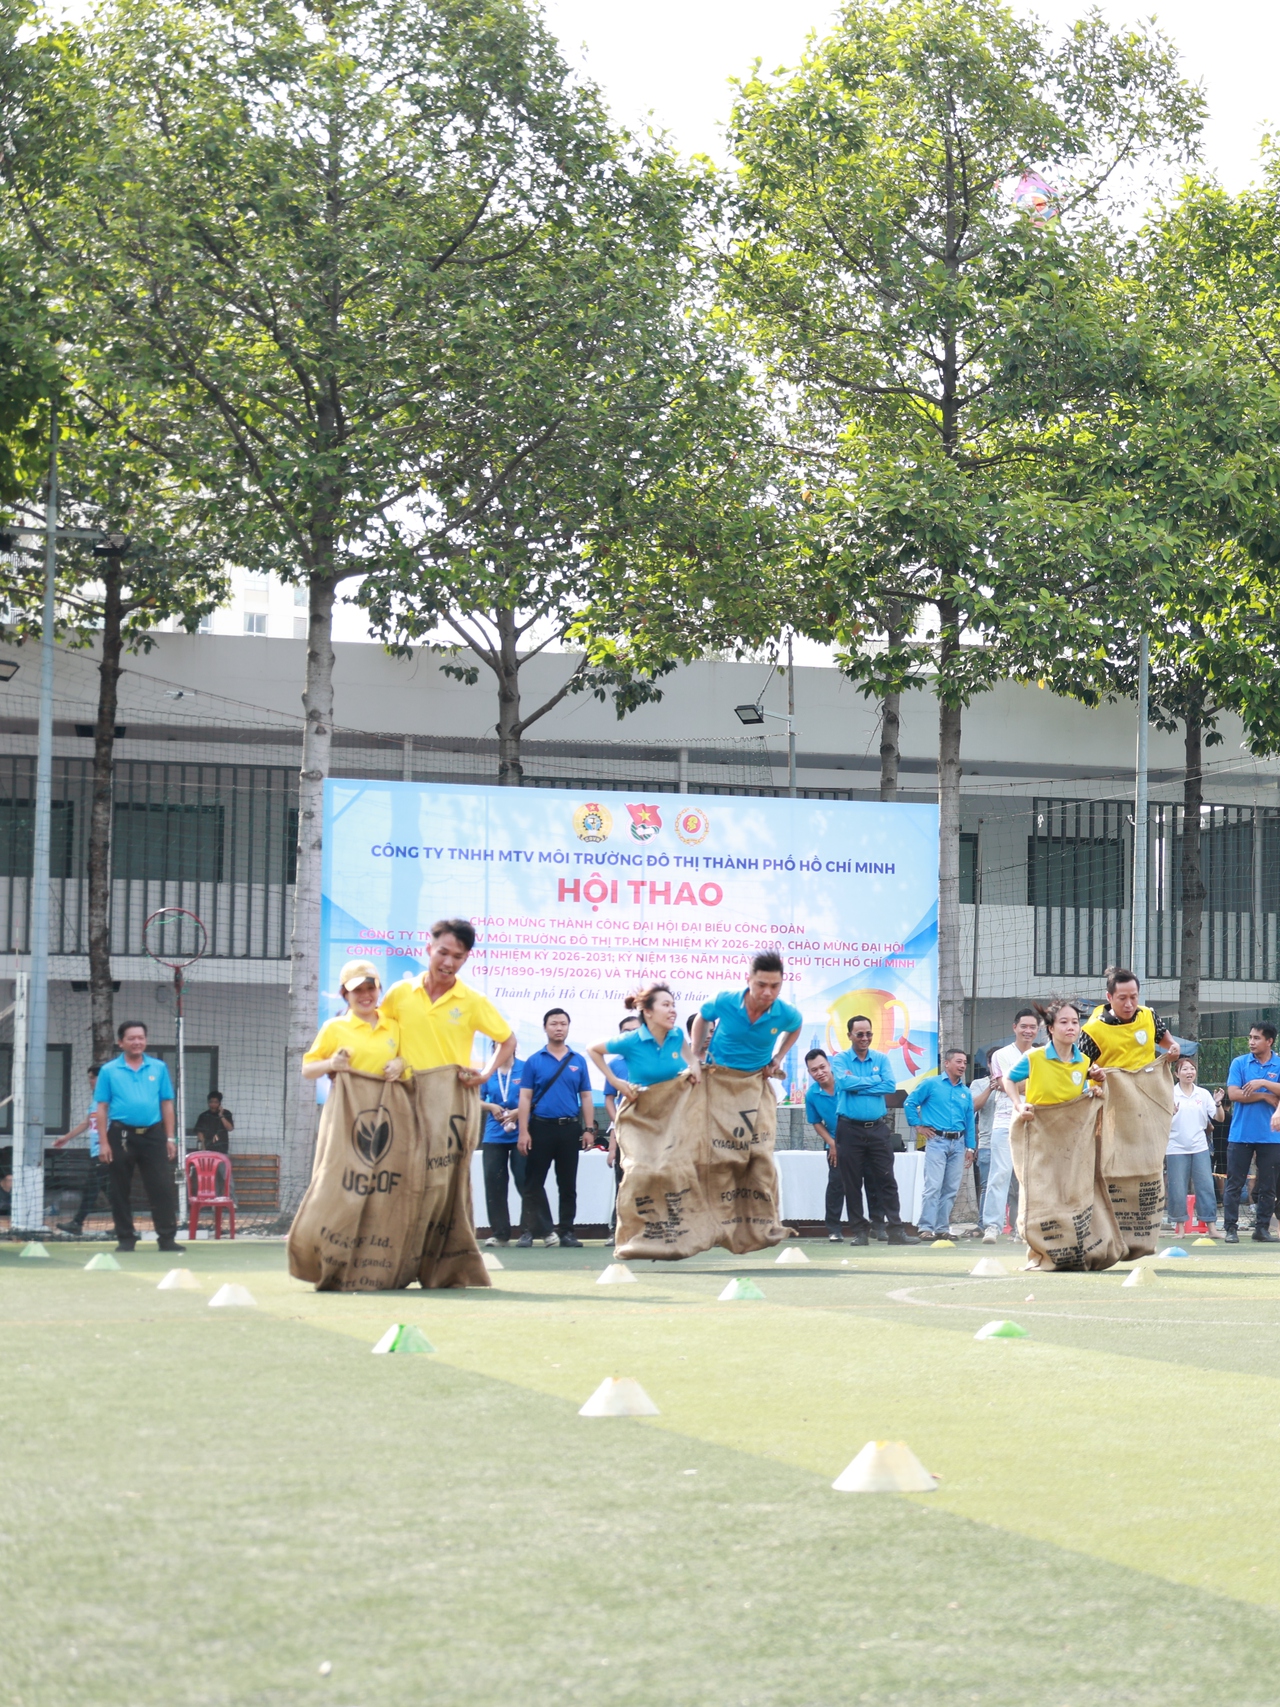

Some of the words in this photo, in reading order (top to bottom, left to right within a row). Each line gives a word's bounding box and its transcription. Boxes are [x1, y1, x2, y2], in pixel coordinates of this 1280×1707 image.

[371, 842, 419, 859] CÔNG
[423, 847, 444, 860] TY
[447, 847, 494, 862] TNHH
[499, 849, 535, 863] MTV
[538, 848, 570, 864] MÔI
[574, 850, 643, 866] TRƯỜNG
[646, 852, 670, 867] ĐÔ
[673, 855, 699, 872] THỊ
[703, 854, 759, 870] THÀNH
[762, 854, 796, 871] PHỐ
[799, 855, 822, 872] HỒ
[825, 858, 852, 873] CHÍ
[855, 861, 895, 875] MINH
[557, 871, 619, 913] HỘI
[626, 879, 723, 907] THAO
[359, 927, 395, 941] CÔNG
[398, 930, 414, 941] TY
[469, 915, 505, 927] CHÀO
[508, 915, 546, 928] MỪNG
[549, 918, 593, 930] THÀNH
[596, 918, 630, 931] CÔNG
[633, 921, 654, 933] ĐẠI
[657, 919, 678, 934] HỘI
[681, 922, 702, 935] ĐẠI
[734, 921, 767, 934] CÔNG
[770, 922, 805, 935] ĐOÀN
[487, 931, 512, 944] MÔI
[515, 932, 567, 946] TRƯỜNG
[569, 933, 588, 946] ĐÔ
[591, 936, 611, 948] THỊ
[614, 937, 659, 948] TP.HCM
[662, 936, 702, 950] NHIỆM
[787, 939, 821, 951] CHÀO
[823, 939, 859, 952] MỪNG
[861, 942, 881, 955] ĐẠI
[883, 941, 905, 955] HỘI
[346, 944, 382, 957] CÔNG
[385, 945, 423, 957] ĐOÀN
[490, 948, 531, 962] NHIỆM
[552, 951, 616, 964] 2026-2031;
[636, 950, 667, 965] NIỆM
[669, 953, 689, 964] 136
[814, 957, 840, 969] TỊCH
[863, 956, 882, 969] CHÍ
[884, 958, 915, 969] MINH
[471, 964, 602, 981] (19/5/1890-19/5/2026)
[604, 966, 621, 979] VÀ
[624, 966, 667, 980] THÁNG
[669, 967, 703, 981] CÔNG
[706, 968, 741, 981] NHÂN
[494, 986, 531, 999] Thành
[533, 984, 556, 1001] phố
[558, 985, 576, 1000] Hồ
[579, 987, 601, 1001] Chí
